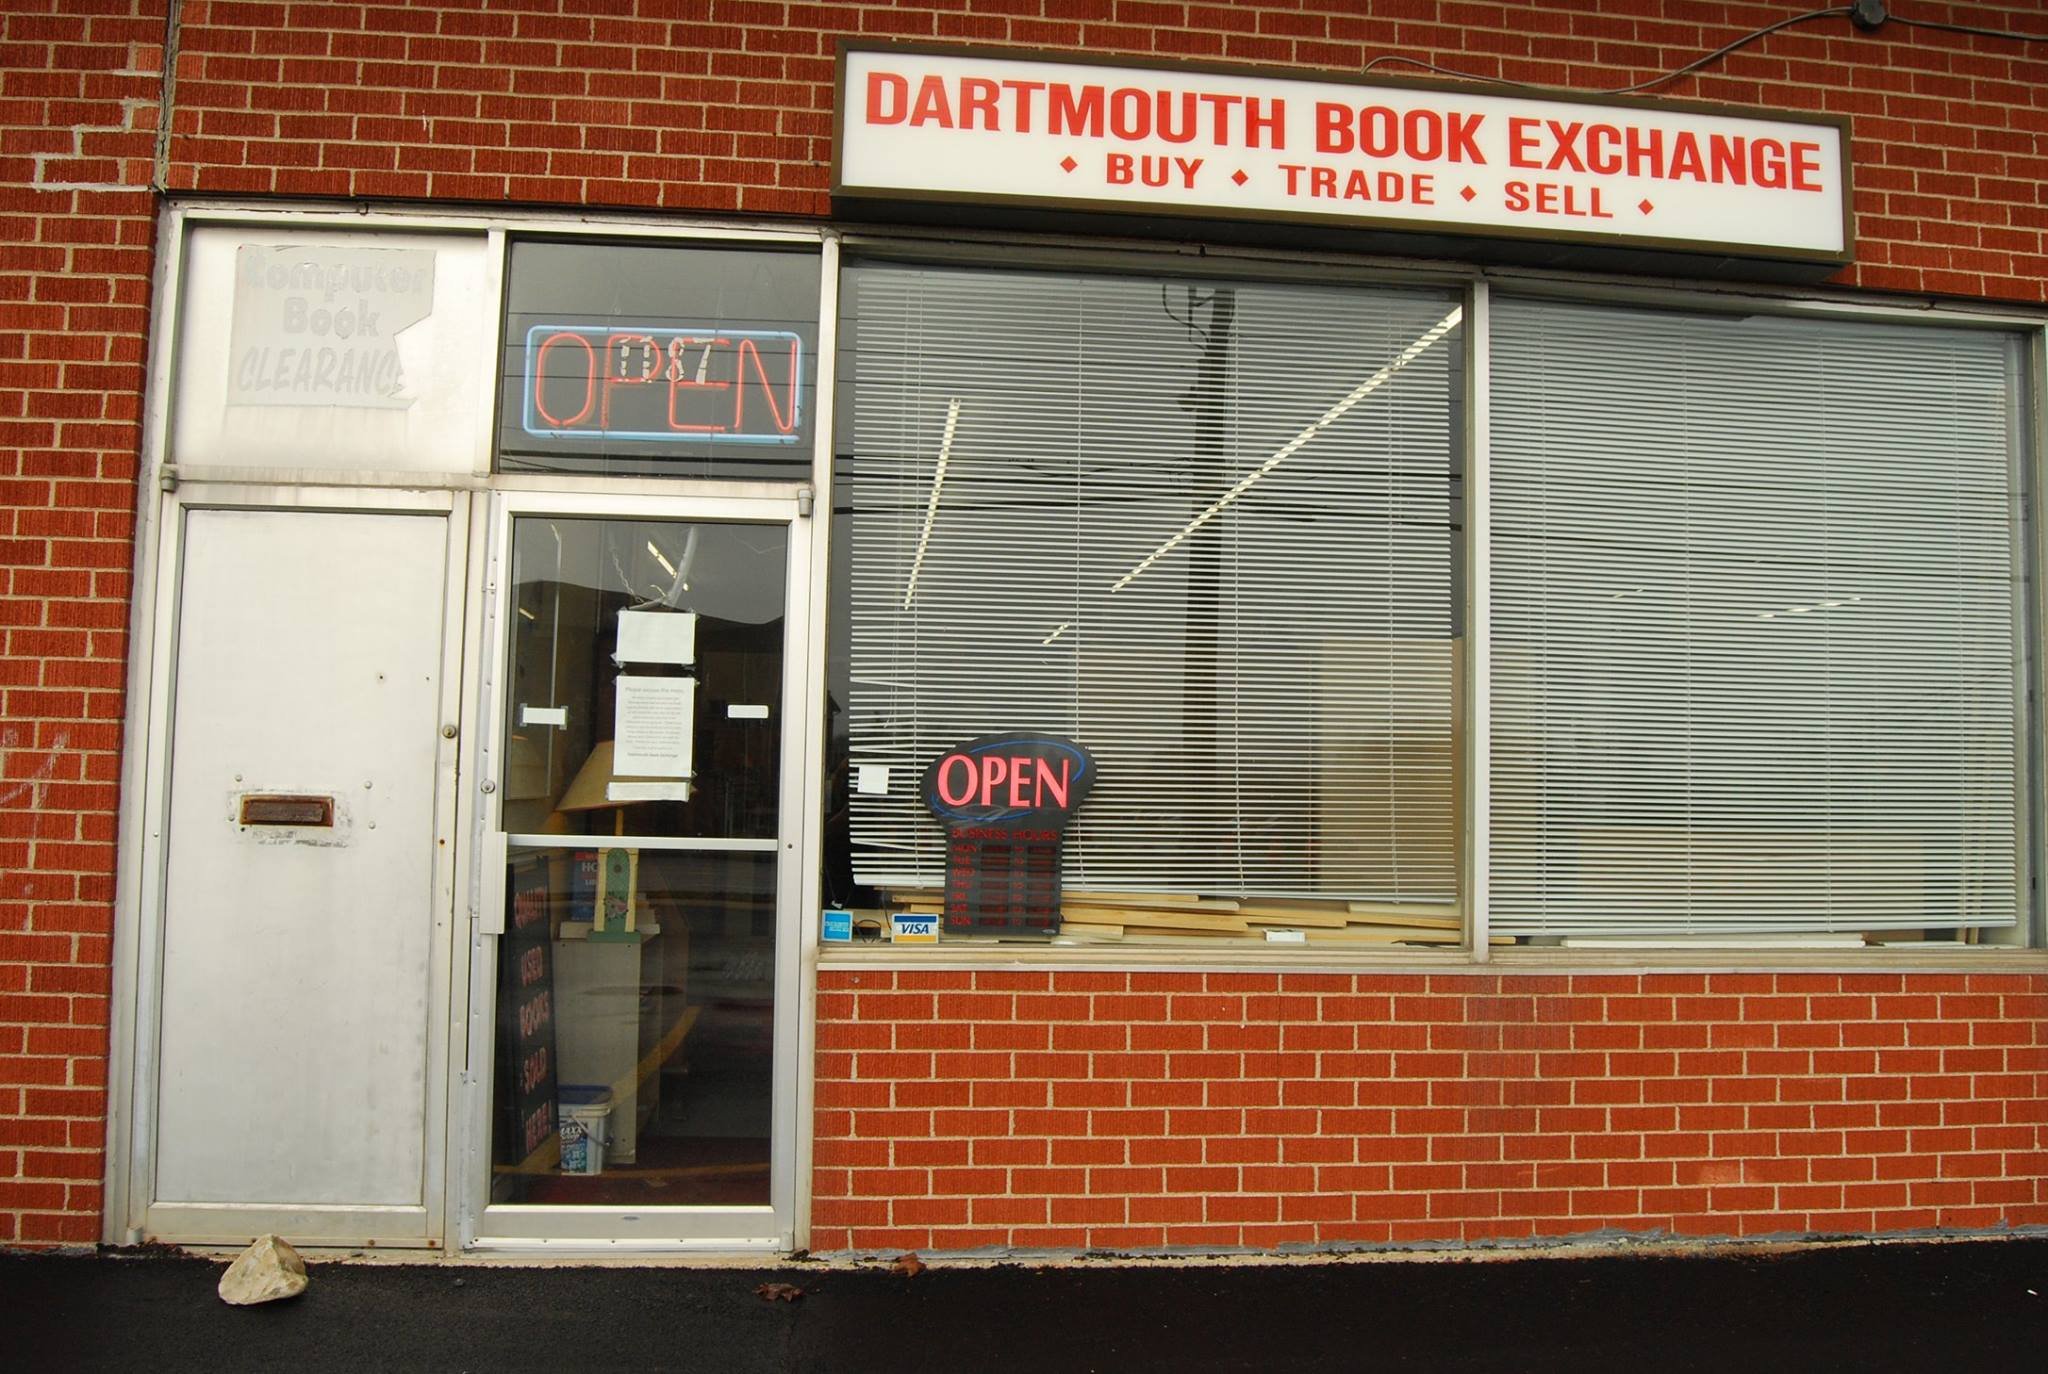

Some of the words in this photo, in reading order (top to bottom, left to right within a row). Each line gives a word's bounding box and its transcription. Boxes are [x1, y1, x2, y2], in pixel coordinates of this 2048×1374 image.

[865, 71, 1286, 151] DARTMOUTH
[1315, 101, 1488, 166] BOOK
[1508, 117, 1824, 194] EXCHANGE
[1106, 152, 1204, 190] BUY
[1277, 164, 1435, 206] TRADE
[1504, 180, 1614, 219] SELL
[246, 253, 427, 302] Computer
[283, 296, 381, 339] Book
[535, 332, 798, 434] OPEN
[937, 753, 1071, 809] OPEN
[901, 923, 930, 935] VISA
